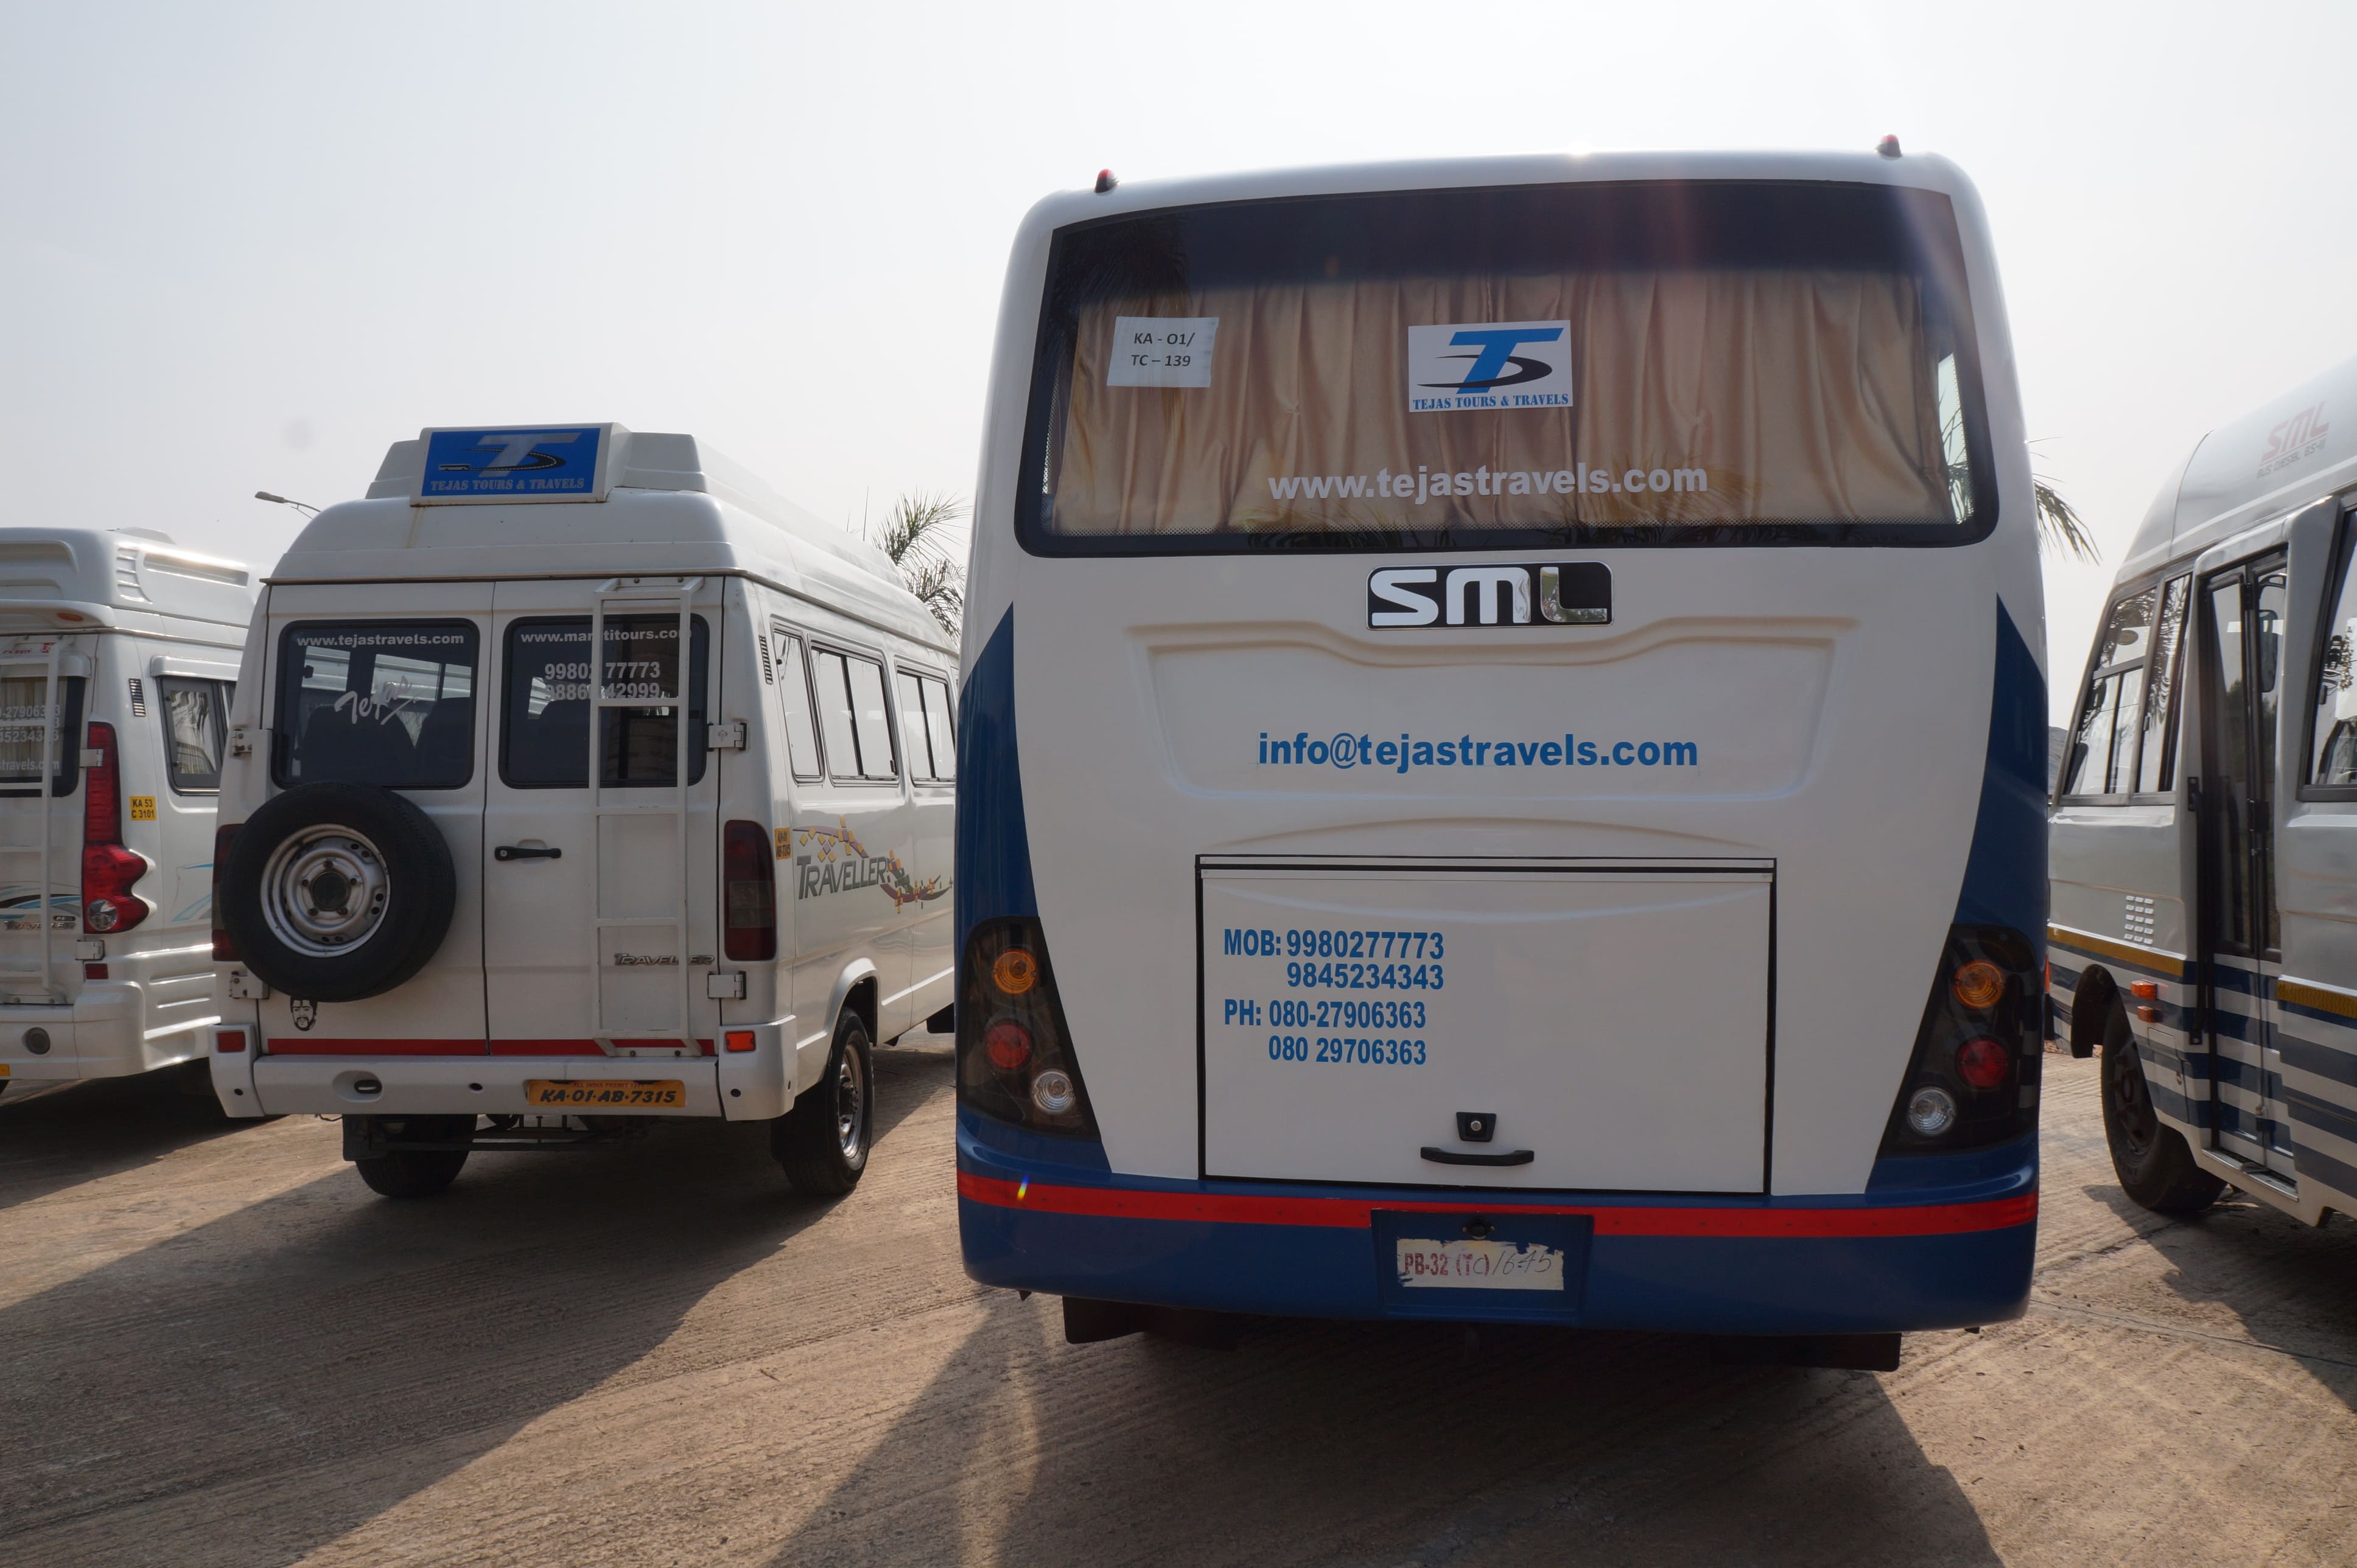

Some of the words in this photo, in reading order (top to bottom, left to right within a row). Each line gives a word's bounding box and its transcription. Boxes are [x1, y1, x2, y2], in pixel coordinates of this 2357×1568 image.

[1134, 333, 1153, 344] KA
[1131, 355, 1149, 366] TC
[1165, 355, 1191, 366] 139
[1413, 398, 1451, 410] TEJAS
[1455, 396, 1496, 408] TOURS
[1500, 396, 1509, 406] &
[1513, 394, 1569, 405] TRAVELS
[431, 480, 468, 491] TEJAS
[472, 479, 513, 490] TOURS
[516, 480, 525, 489] &
[529, 478, 585, 489] TRAVELS
[1268, 462, 1708, 505] www.tejastravels.com
[1370, 566, 1608, 626] SML
[297, 634, 464, 648] www.tejastravels.com
[521, 629, 692, 643] www.martitours.co
[1258, 732, 1698, 774] info@tejastravels.com
[132, 799, 142, 808] KA
[145, 799, 153, 808] 53
[131, 810, 137, 819] C
[139, 810, 155, 819] 3101
[796, 855, 889, 900] TRAVELLER
[1224, 929, 1281, 956] MOB:
[1287, 929, 1444, 959] 9980277773
[615, 953, 715, 965] TRAVELER
[1287, 962, 1444, 990] 9845234343
[1225, 999, 1261, 1026] PH:
[1269, 1000, 1426, 1028] 080-27906363
[1269, 1035, 1309, 1062] 080
[1315, 1037, 1426, 1065] 29706363
[1404, 1253, 1448, 1276] PB-32
